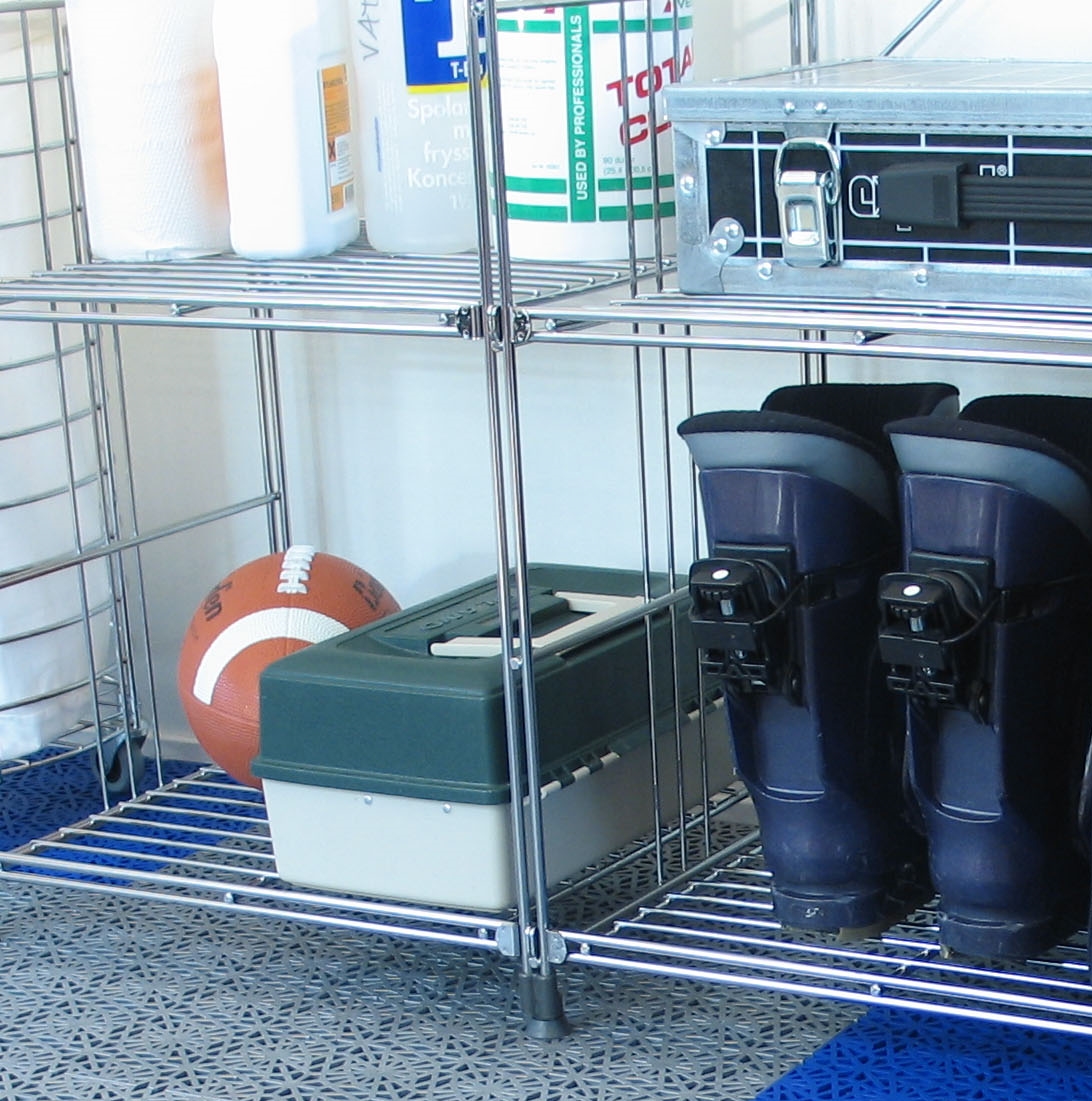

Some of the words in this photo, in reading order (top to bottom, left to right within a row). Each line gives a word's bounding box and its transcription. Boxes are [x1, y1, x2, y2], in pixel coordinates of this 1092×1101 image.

[570, 14, 586, 136] PROFESSIONALS
[574, 138, 587, 158] BY
[575, 161, 588, 201] USED
